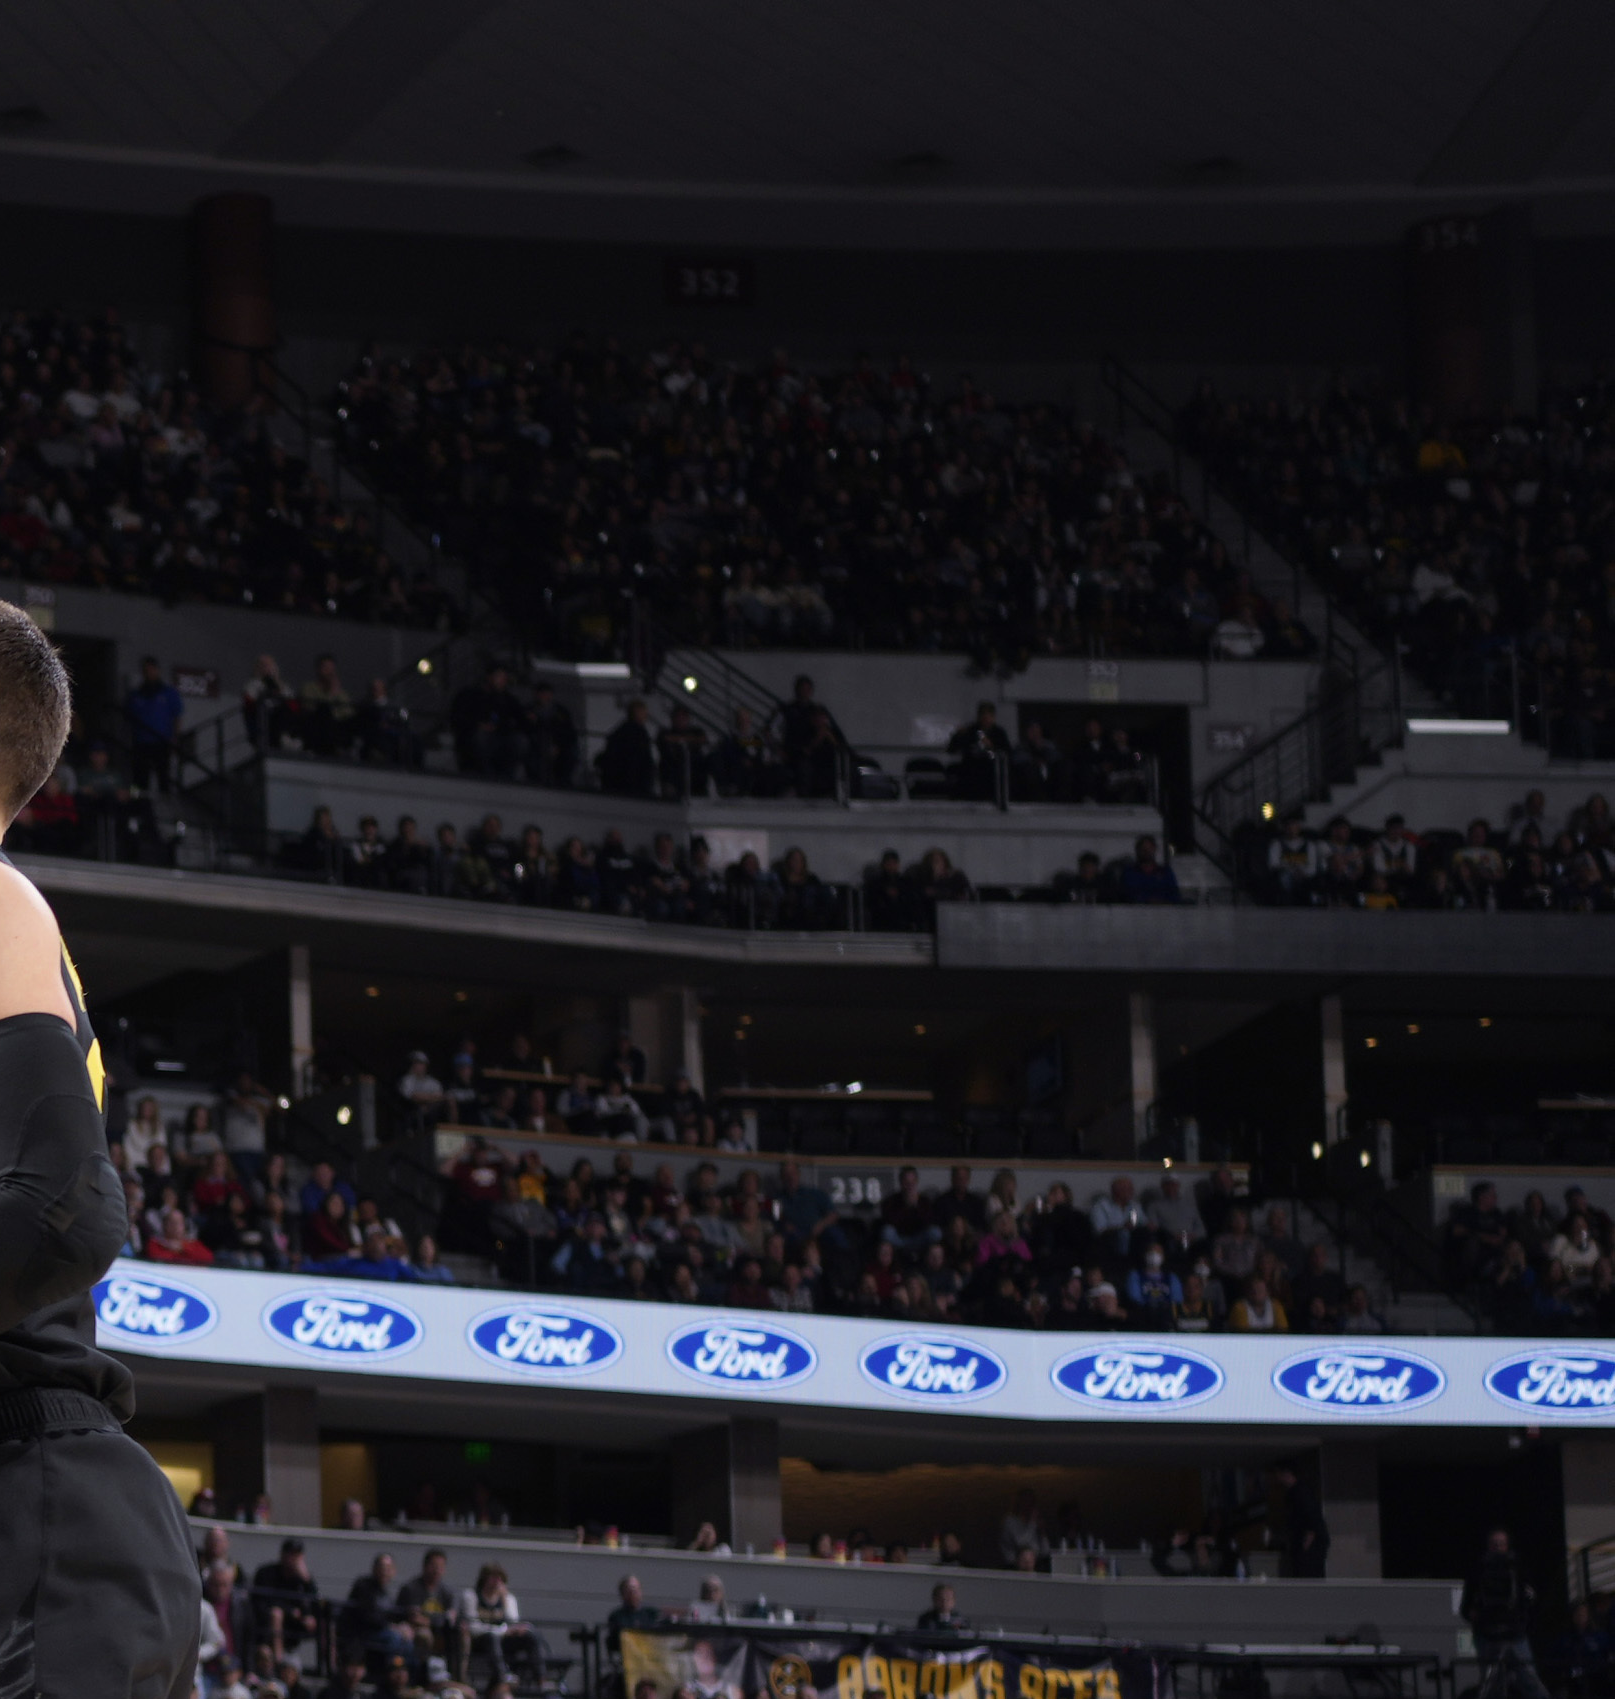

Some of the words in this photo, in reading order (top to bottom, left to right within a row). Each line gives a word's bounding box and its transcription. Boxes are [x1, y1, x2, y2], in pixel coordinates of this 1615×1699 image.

[679, 267, 740, 298] 352
[830, 1176, 882, 1204] 238
[98, 1278, 186, 1338] Ford
[291, 1295, 392, 1352] Ford
[496, 1310, 593, 1366] Ford
[694, 1325, 789, 1382] Ford
[886, 1340, 977, 1393] Ford
[1083, 1348, 1191, 1402] Ford
[1305, 1353, 1412, 1405] Ford
